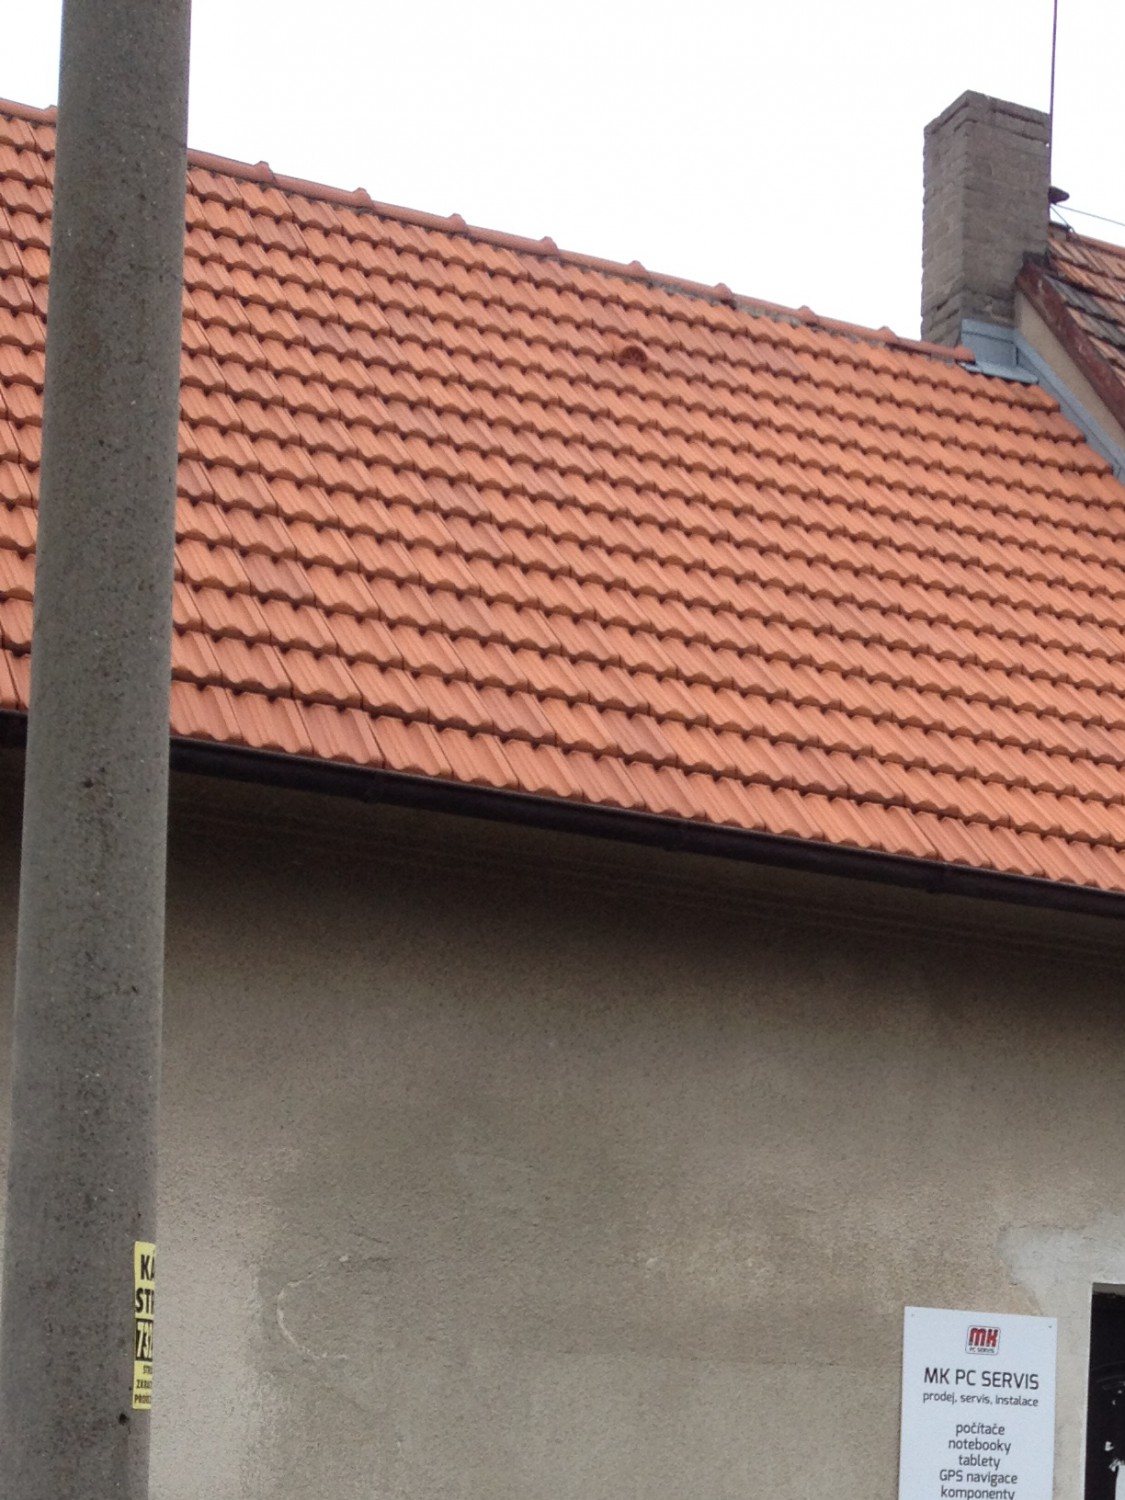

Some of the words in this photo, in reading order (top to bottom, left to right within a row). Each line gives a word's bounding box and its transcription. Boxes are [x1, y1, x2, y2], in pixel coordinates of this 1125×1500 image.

[968, 1327, 999, 1347] MK
[923, 1367, 950, 1384] MK
[955, 1369, 977, 1386] PC
[981, 1370, 1040, 1390] SERVIS
[923, 1391, 957, 1404] prodej,
[960, 1394, 993, 1405] servis,
[995, 1395, 1039, 1407] instalace
[955, 1422, 1006, 1437] počítače
[948, 1438, 1012, 1455] notebooky
[959, 1454, 1001, 1471] tablety
[940, 1469, 963, 1482] GPS
[966, 1472, 1018, 1487] navigace
